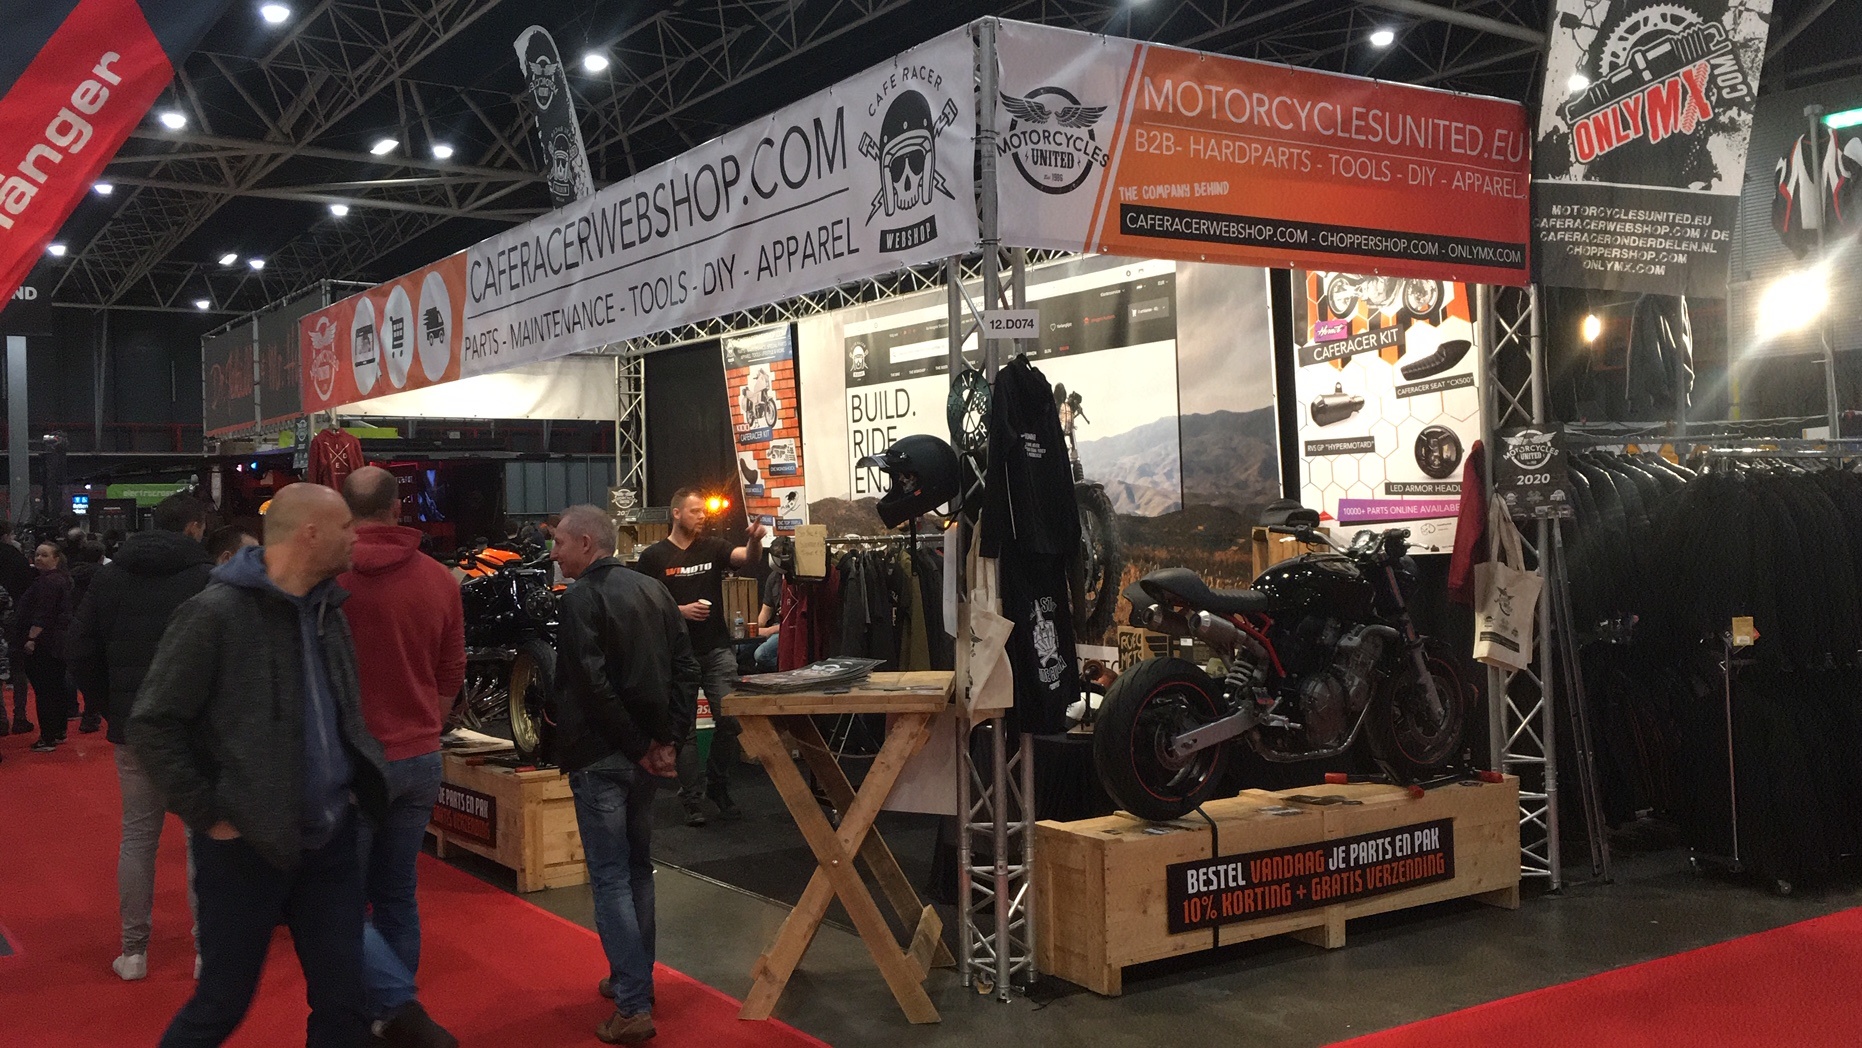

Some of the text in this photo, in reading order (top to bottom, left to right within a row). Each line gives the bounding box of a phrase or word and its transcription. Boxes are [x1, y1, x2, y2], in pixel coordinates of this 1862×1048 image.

[868, 65, 943, 117] CAFE RACER
[1144, 76, 1524, 163] MOTORCYCLESUNITED.EU
[996, 129, 1110, 168] MOTORCYCLES
[1031, 148, 1075, 169] UNITED
[1190, 135, 1311, 172] HARDPARTS
[1329, 154, 1391, 182] TOOLS
[1408, 164, 1436, 187] DIY
[1119, 181, 1229, 201] THE COMPANY BEHIND
[470, 106, 847, 304] CAFERACERWEBSHOP.COM
[1552, 205, 1712, 226] MOTORCYCLESUNITED.EU
[886, 222, 931, 250] WEBSHOP
[1126, 212, 1308, 244] CAFERACERWEBSHOP.COM
[1319, 231, 1438, 256] CHOPPERSHOP.COM
[1448, 243, 1521, 263] ONLYMX.COM
[1533, 217, 1700, 239] CAFERACERWEBSHOP.COM
[1711, 230, 1729, 241] DE
[1539, 231, 1718, 254] CAFERACERONDERDELEN.NL
[1566, 244, 1687, 264] CHOPPERSHOP.COM
[1583, 259, 1666, 276] ONLYMX.COM
[465, 328, 499, 361] PARTS
[510, 293, 616, 350] MAINTENANCE
[628, 270, 687, 317] TOOLS
[703, 253, 736, 296] DIY
[757, 217, 860, 281] APPAREL
[989, 318, 1035, 330] 12.D074
[1313, 328, 1399, 361] CAFERACER KIT
[1397, 383, 1430, 396] CAFERACER
[1430, 380, 1446, 390] SEAT
[851, 387, 916, 423] BUILD.
[740, 431, 763, 442] CAFERACER
[1307, 444, 1317, 452] RVS
[1325, 441, 1374, 450] "HYPERMOTARD"
[1503, 444, 1560, 460] MOTORCYCLES
[1520, 452, 1542, 460] UNITED
[1390, 485, 1404, 493] LED
[1405, 485, 1433, 493] ARMOR
[1516, 473, 1551, 486] 2020
[1343, 508, 1365, 516] 10000+
[1367, 506, 1389, 515] PARTS
[1390, 505, 1419, 514] ONLINE
[445, 788, 465, 812] PARTS
[465, 795, 475, 814] EN
[475, 797, 489, 819] PAK
[1186, 827, 1440, 894] BESTEL VANDAAG JE PARTS EN PAK
[1183, 852, 1445, 924] 10% KORTING + GRATIS VERZENDING
